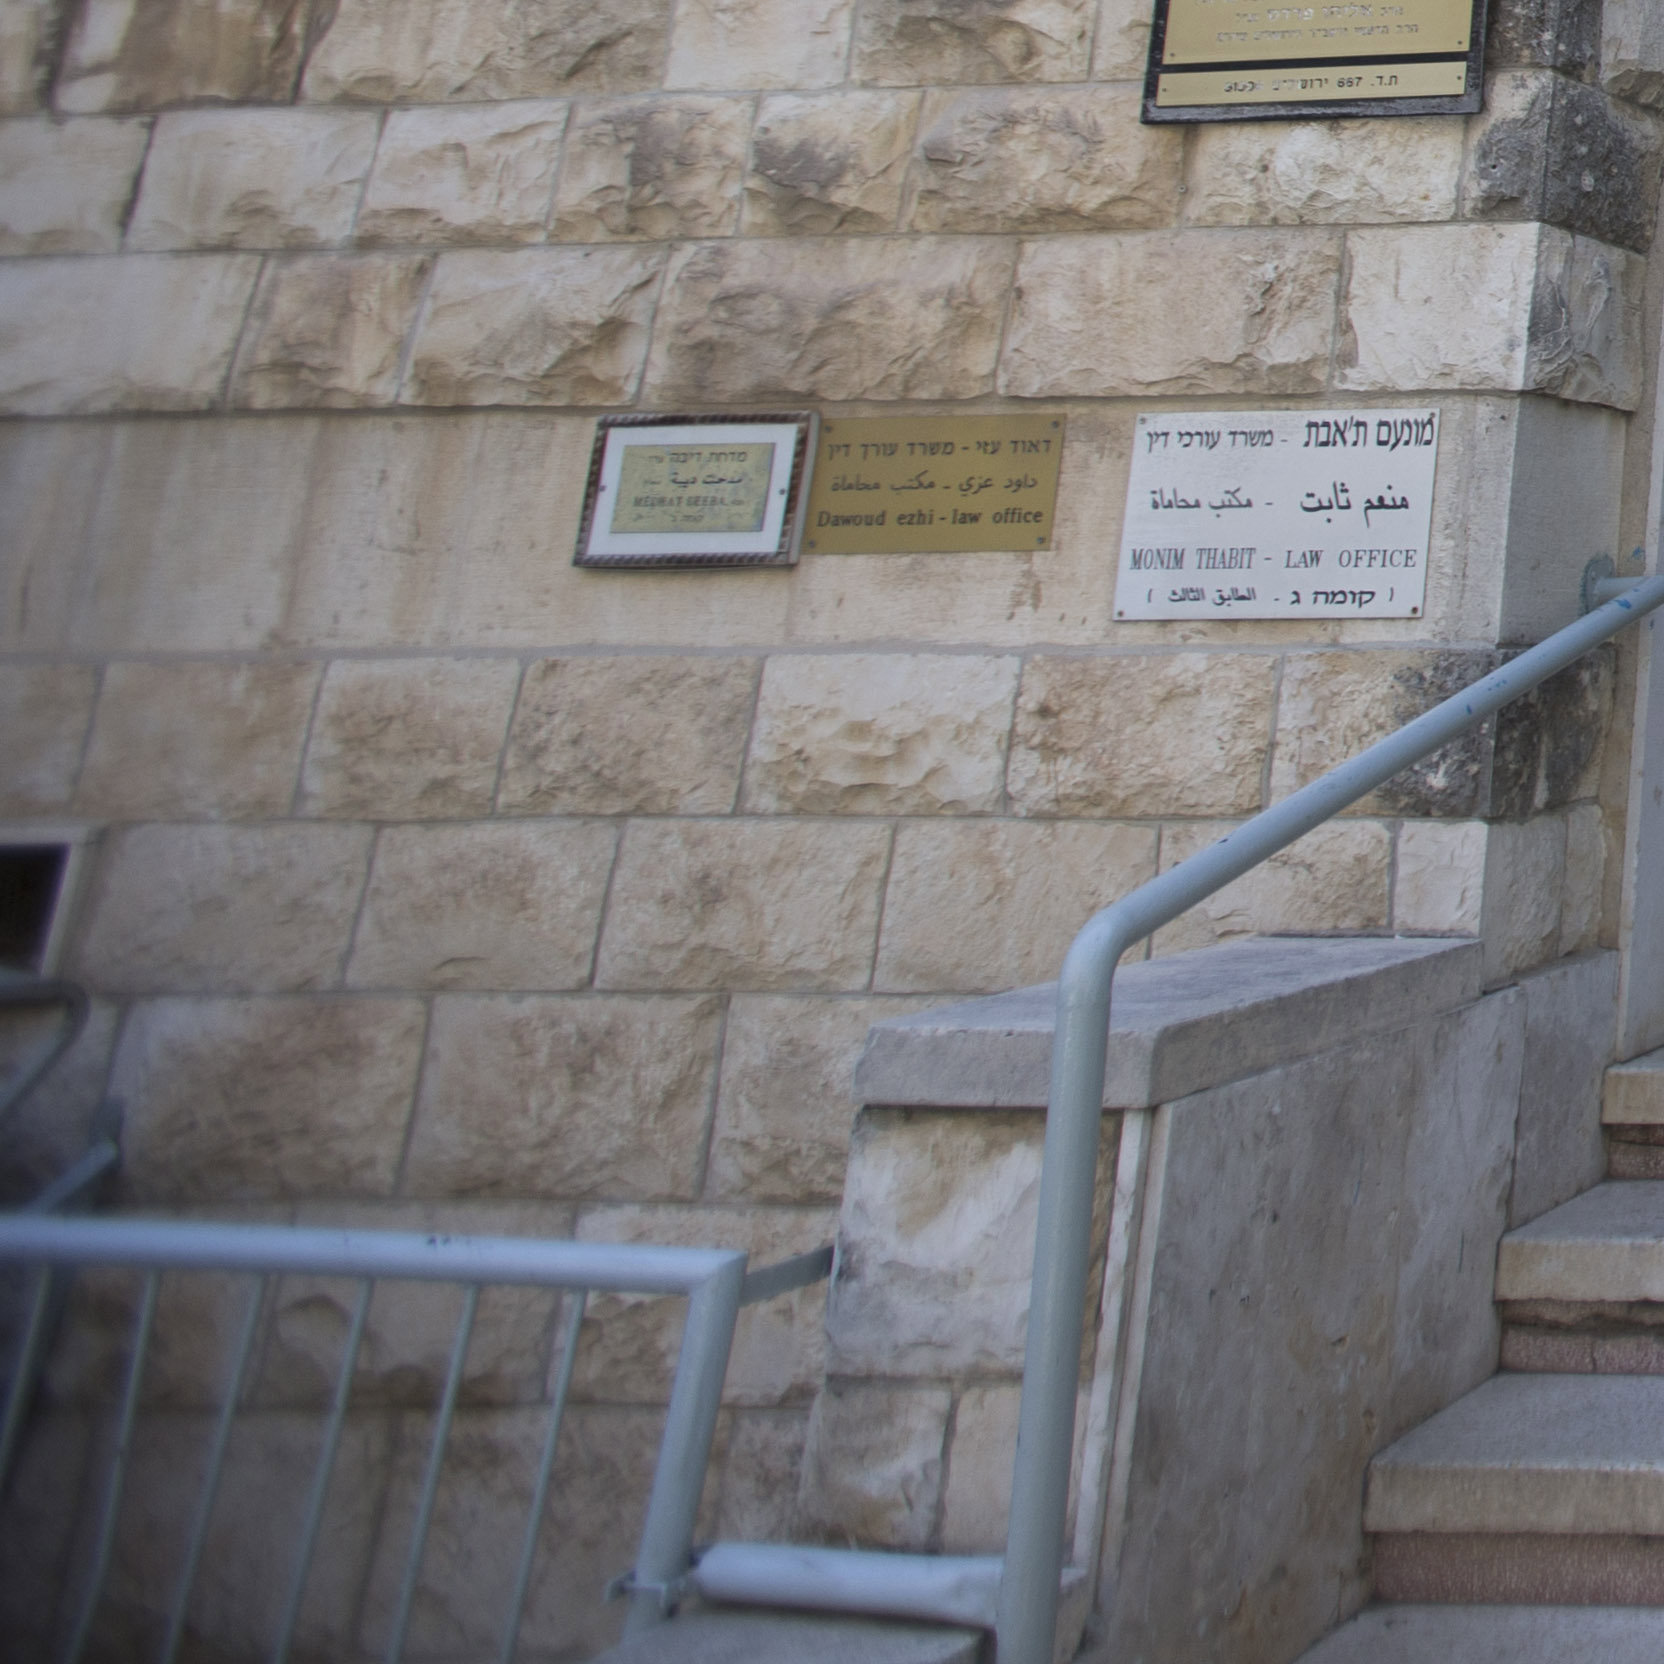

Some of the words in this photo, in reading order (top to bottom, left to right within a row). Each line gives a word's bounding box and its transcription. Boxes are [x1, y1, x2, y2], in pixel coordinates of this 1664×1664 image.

[1145, 429, 1170, 453] דין
[1176, 429, 1222, 452] עורכי
[1228, 428, 1275, 449] משרד
[1375, 415, 1435, 453] מונעם
[859, 442, 899, 462] עורך
[906, 440, 956, 457] משרד
[975, 439, 1003, 456] עזי
[1010, 438, 1053, 455] דאוד
[830, 472, 881, 493] محاماة
[889, 469, 936, 496] مكتب
[957, 476, 995, 497] عزي
[1003, 472, 1039, 493] داود
[1149, 487, 1202, 511] محاماة
[1208, 486, 1254, 519] مكتب
[1299, 480, 1352, 524] ثابت
[1362, 483, 1410, 528] منعم
[816, 509, 887, 528] Dawoud
[896, 508, 935, 526] ezhi
[951, 508, 983, 526] law
[991, 506, 1044, 524] office
[1128, 547, 1186, 571] MONIM
[1195, 547, 1257, 570] THABIT
[1284, 548, 1325, 569] LAW
[1338, 548, 1418, 568] OFFICE
[1289, 589, 1302, 606] ג
[1311, 588, 1377, 609] קומה
